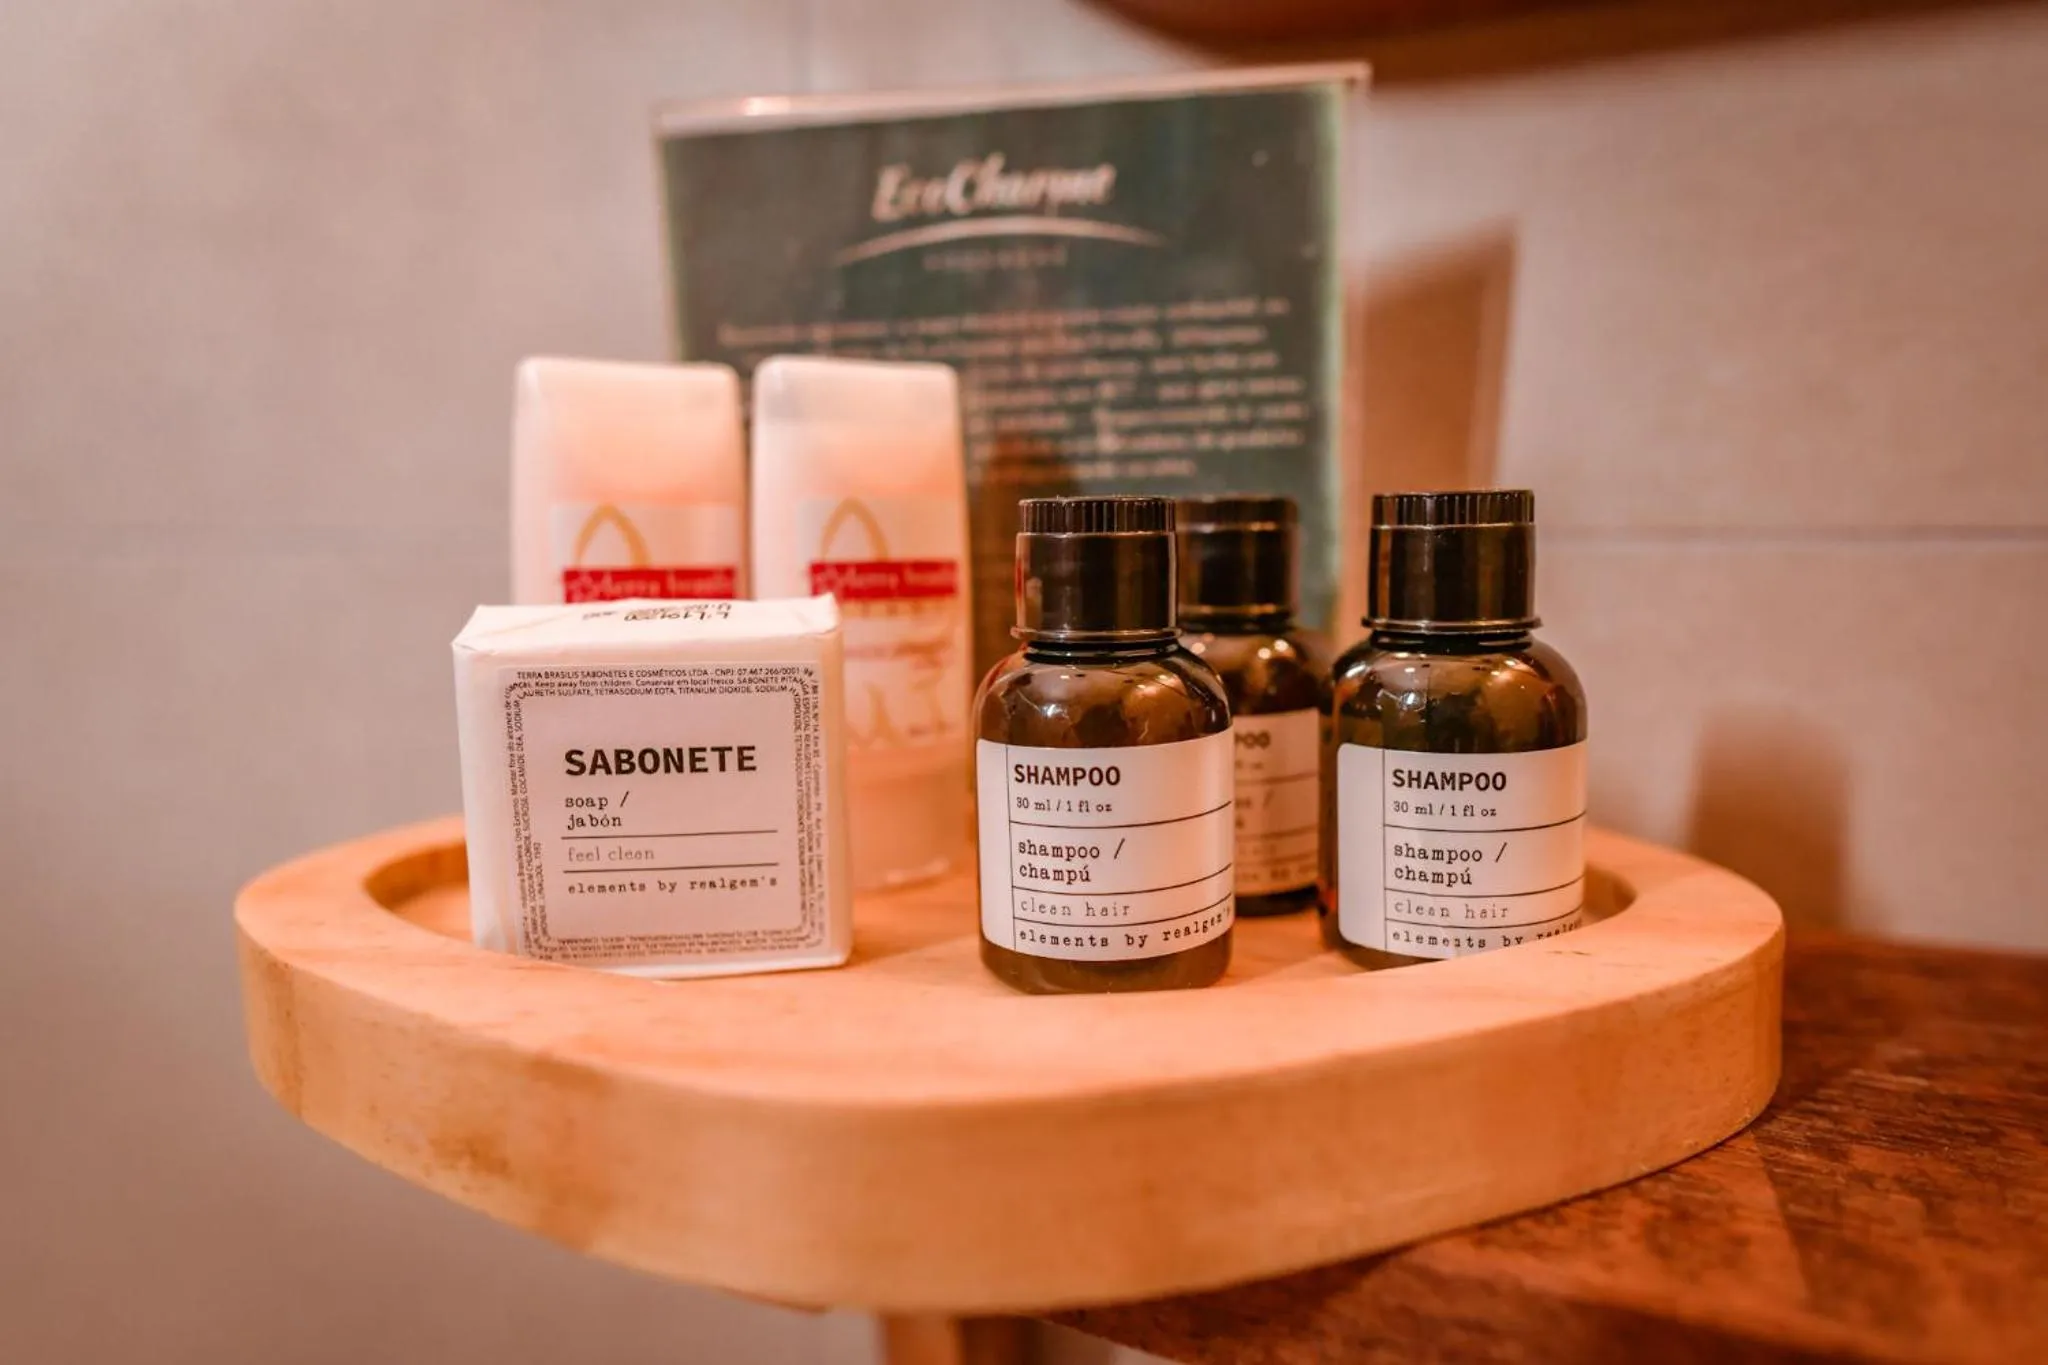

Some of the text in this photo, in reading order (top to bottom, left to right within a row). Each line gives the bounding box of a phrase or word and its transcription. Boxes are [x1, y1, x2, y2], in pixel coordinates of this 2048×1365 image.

[517, 670, 542, 679] TERRA
[544, 670, 579, 678] BRASILIS
[580, 670, 627, 678] SABONETES
[629, 670, 634, 678] E
[636, 668, 687, 678] COSMÉTICOS
[579, 680, 598, 688] from
[690, 678, 708, 686] local
[737, 676, 778, 684] SABONETE
[596, 688, 652, 696] TETRASODIUM
[679, 686, 716, 694] TITANIUM
[755, 685, 787, 693] SODIUM
[513, 700, 523, 732] SODIUM
[564, 745, 758, 777] SABONETE
[1014, 763, 1122, 787] SHAMPOO
[1392, 768, 1507, 792] SHAMPOO
[564, 790, 630, 810] soap /
[1016, 796, 1112, 812] 30 ml / 1 fl oz
[1393, 800, 1497, 817] 30 ml / 1 fl oz
[567, 814, 623, 831] jabón
[568, 846, 655, 862] feel clean
[1018, 837, 1126, 862] shampoo /
[1394, 842, 1508, 864] shampoo /
[1018, 862, 1092, 886] champú
[1394, 866, 1472, 888] champú
[567, 876, 778, 894] elements by realgem's
[1020, 898, 1130, 917] clean hair
[1394, 899, 1509, 919] clean hair
[1020, 928, 1109, 948] elements
[1124, 932, 1149, 948] by
[1392, 930, 1486, 948] elements
